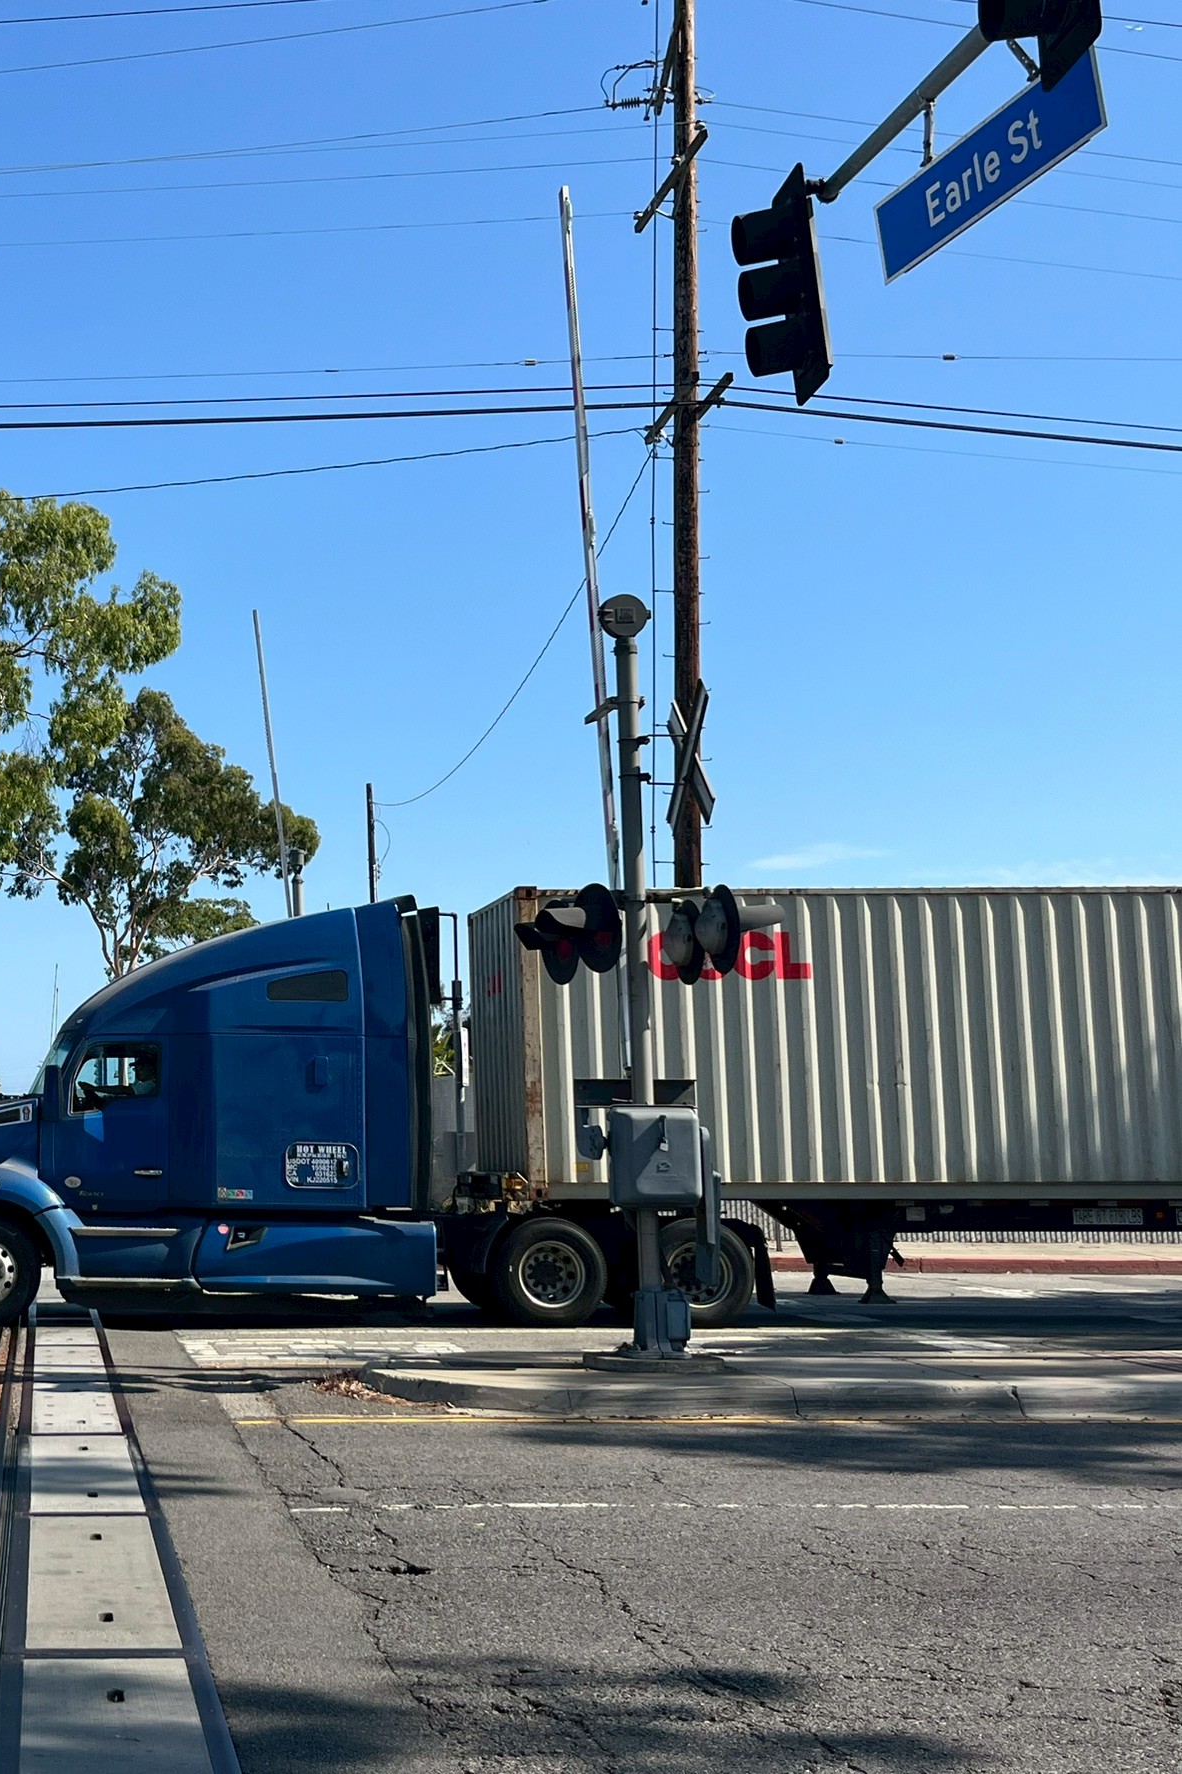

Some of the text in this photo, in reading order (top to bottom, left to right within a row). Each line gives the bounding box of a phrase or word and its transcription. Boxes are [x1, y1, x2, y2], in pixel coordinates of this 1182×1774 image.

[925, 109, 1043, 228] Earle St
[296, 1145, 346, 1154] HOT WHEEL
